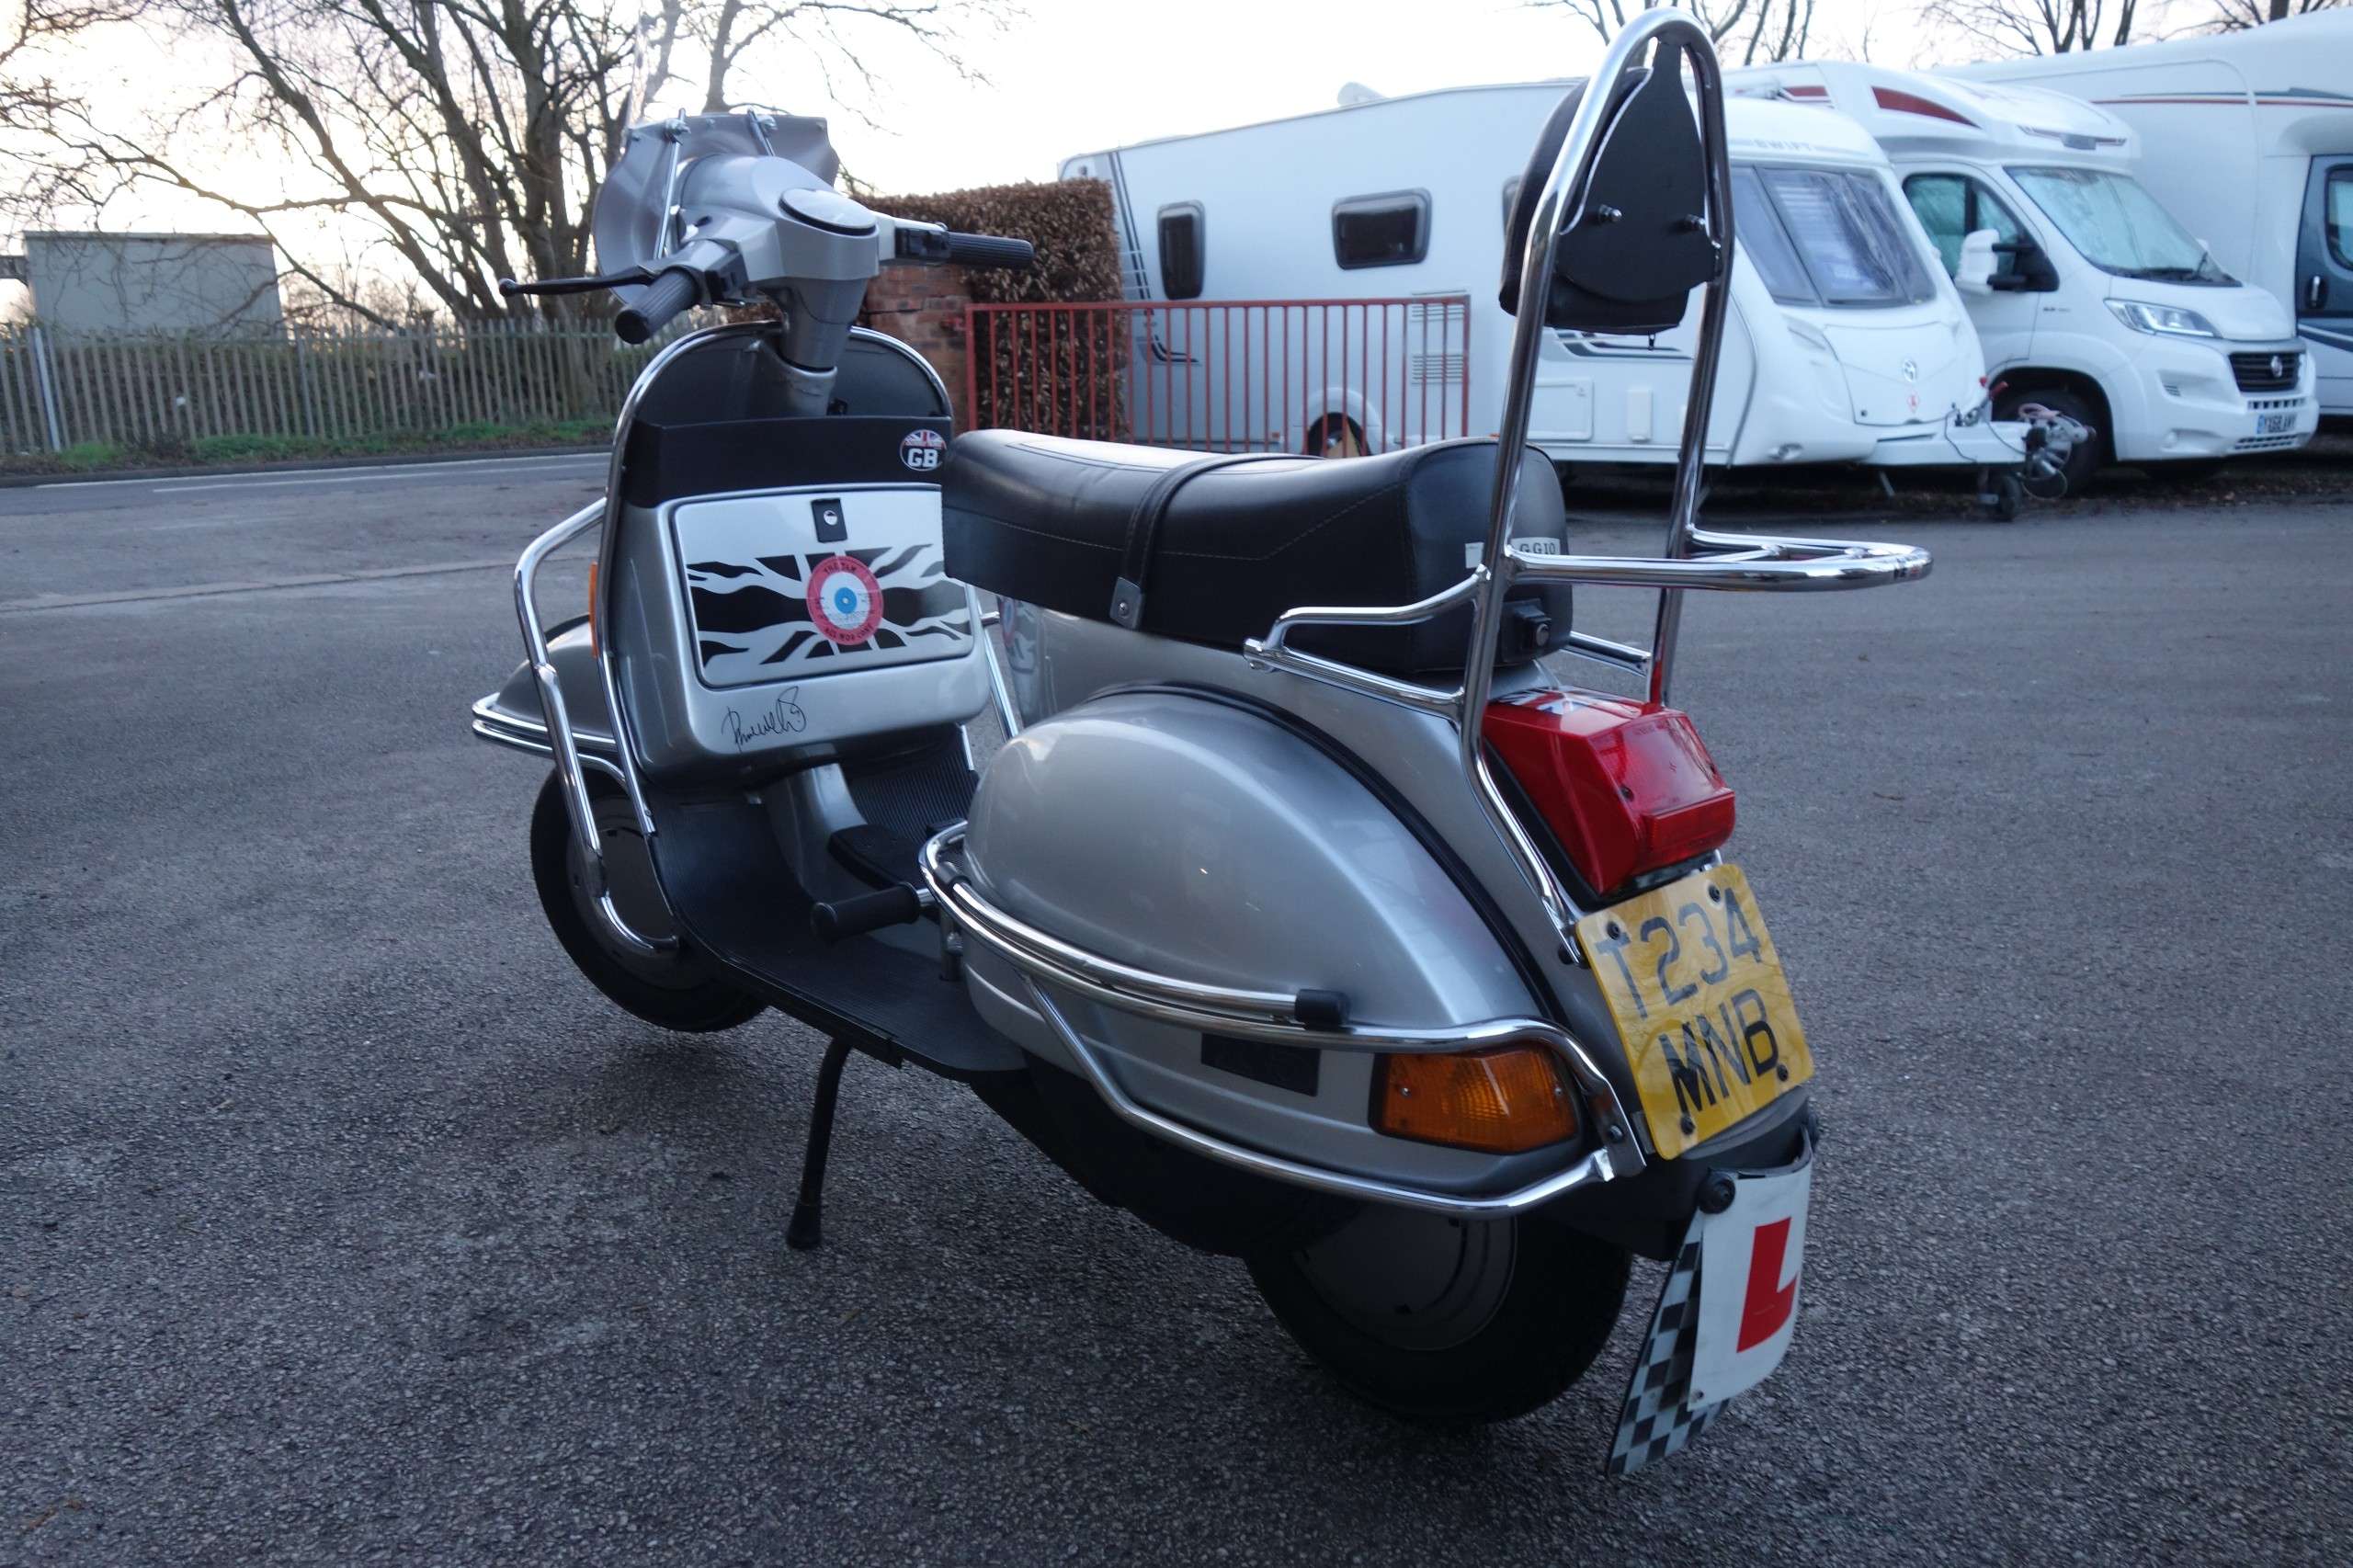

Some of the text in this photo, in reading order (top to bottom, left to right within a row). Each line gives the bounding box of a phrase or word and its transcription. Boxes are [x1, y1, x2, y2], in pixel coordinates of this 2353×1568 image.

[908, 448, 938, 467] GB
[824, 562, 837, 574] THE
[1595, 887, 1762, 1019] T234
[1658, 988, 1780, 1114] MNB
[1736, 1217, 1798, 1354] L
